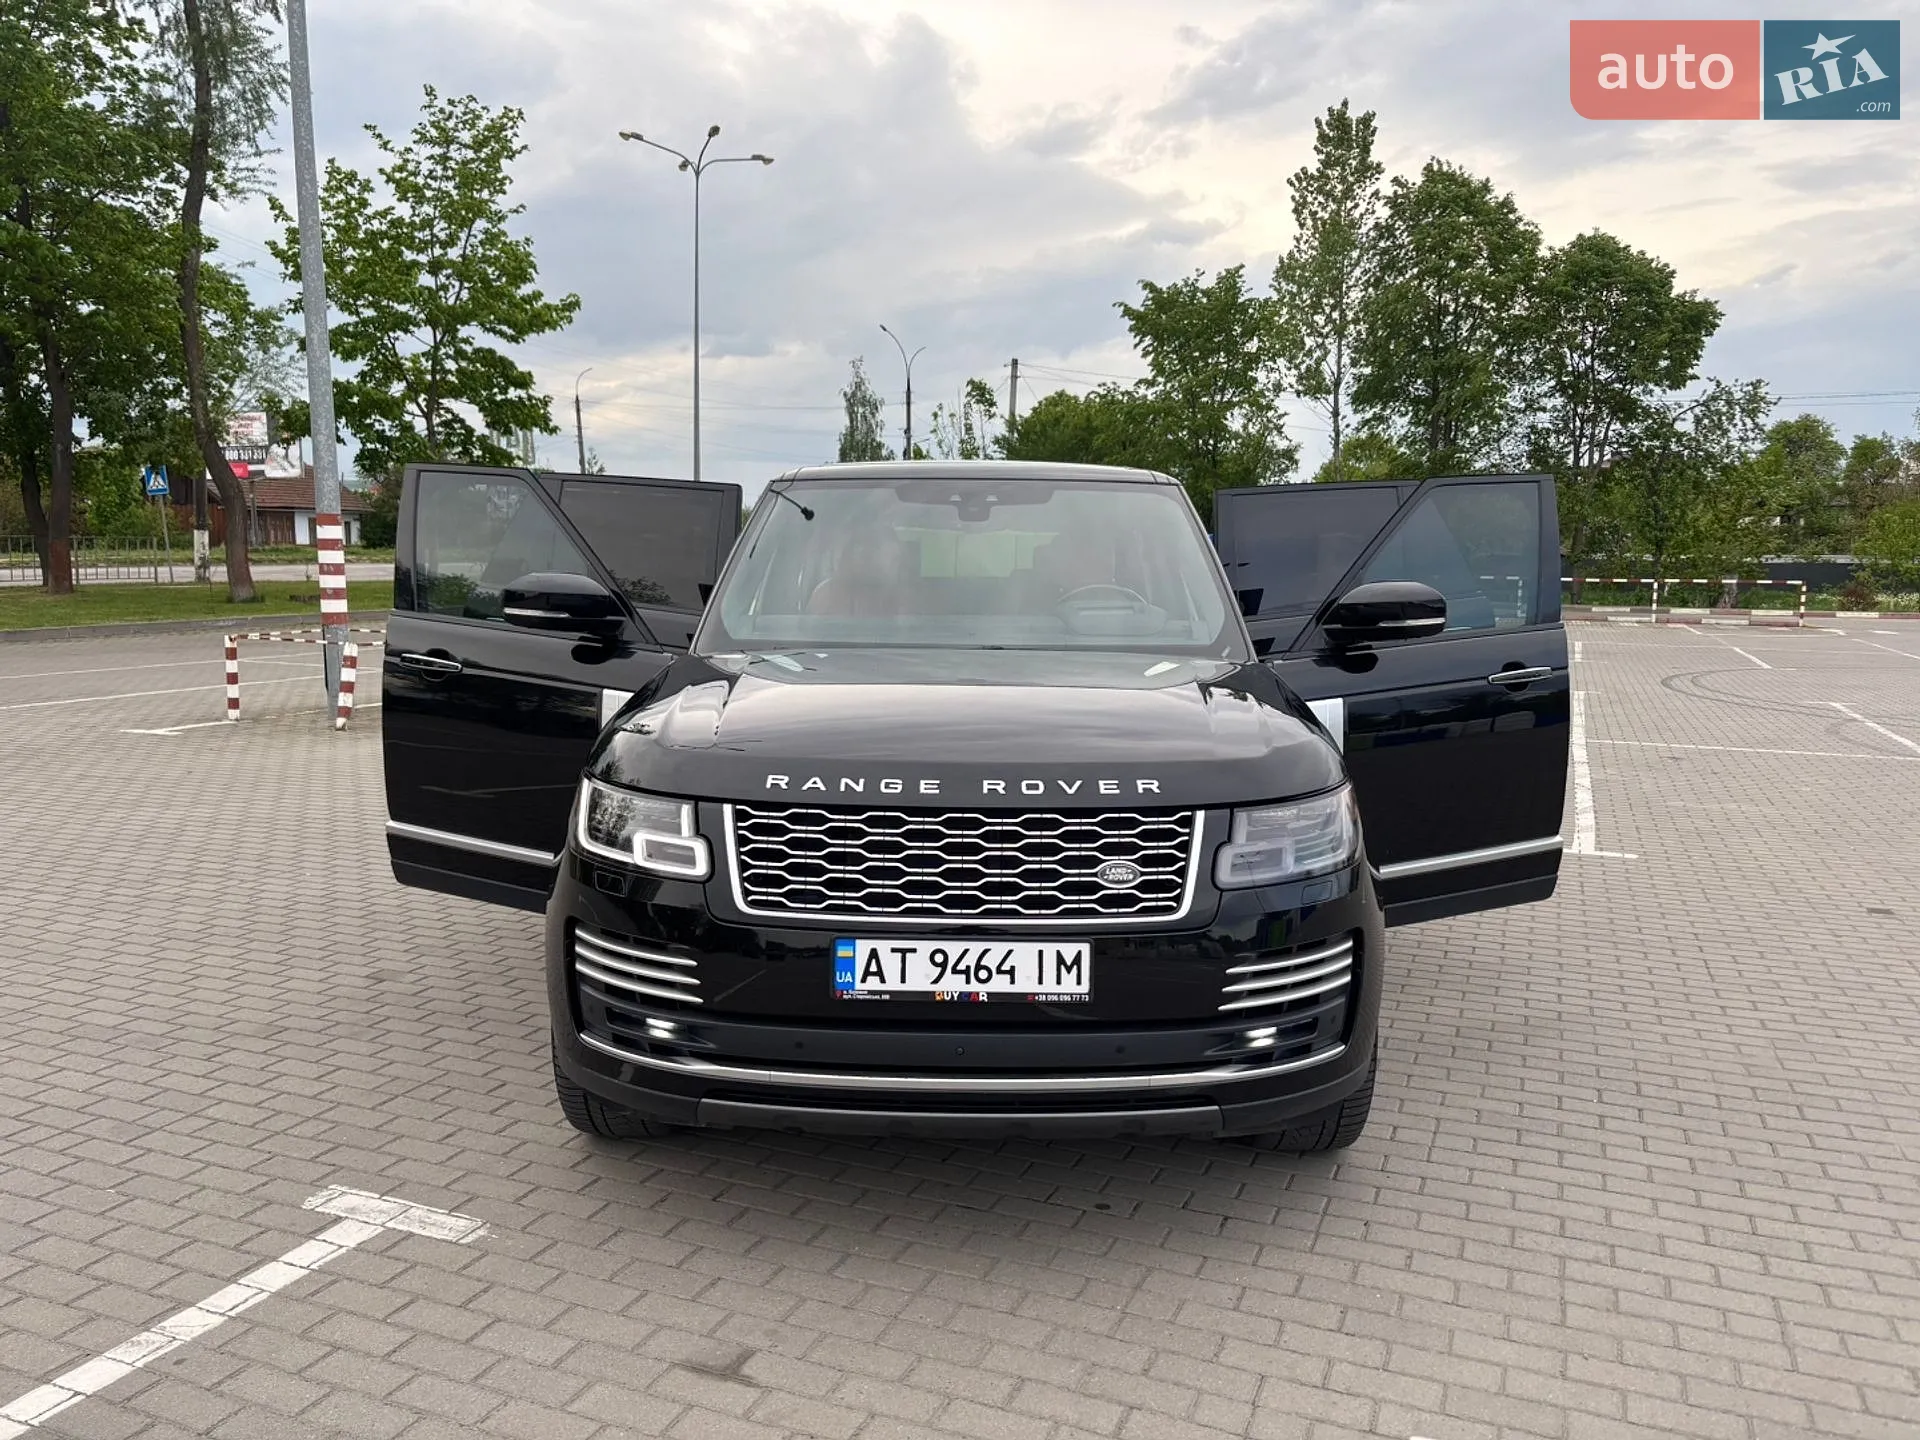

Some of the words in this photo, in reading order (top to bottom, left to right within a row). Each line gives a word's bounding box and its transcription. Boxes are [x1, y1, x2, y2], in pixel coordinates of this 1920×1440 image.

[766, 774, 941, 795] RANGE
[983, 779, 1162, 795] ROVER
[860, 947, 917, 985] AT
[929, 948, 1016, 985] 9464
[1037, 949, 1083, 986] IM
[836, 972, 853, 983] UA
